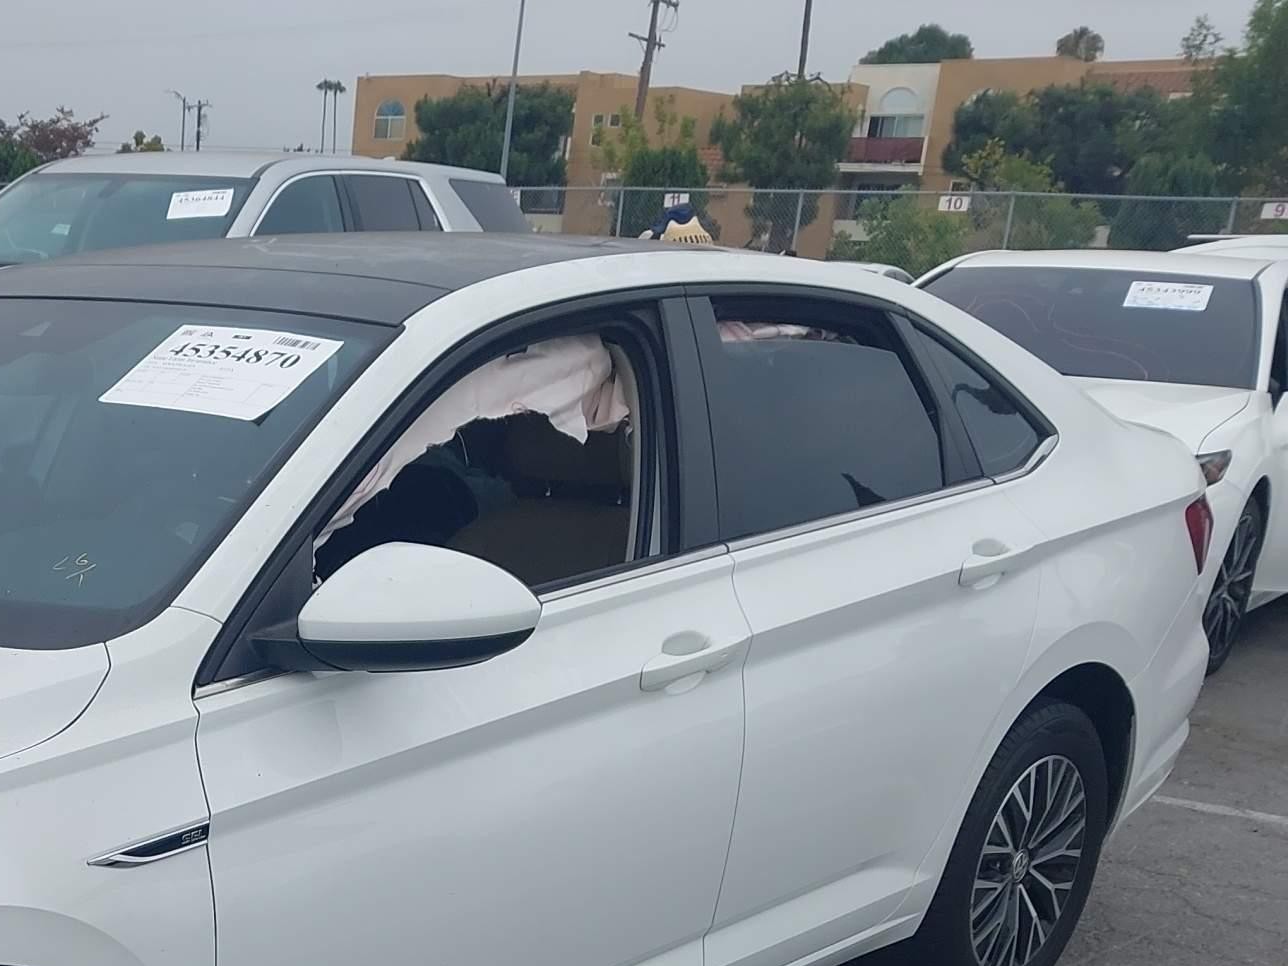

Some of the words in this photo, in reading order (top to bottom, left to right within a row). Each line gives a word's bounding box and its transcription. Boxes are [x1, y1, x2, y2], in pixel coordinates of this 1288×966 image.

[945, 197, 963, 210] 10
[1275, 203, 1286, 217] 9
[169, 341, 302, 370] 45354870
